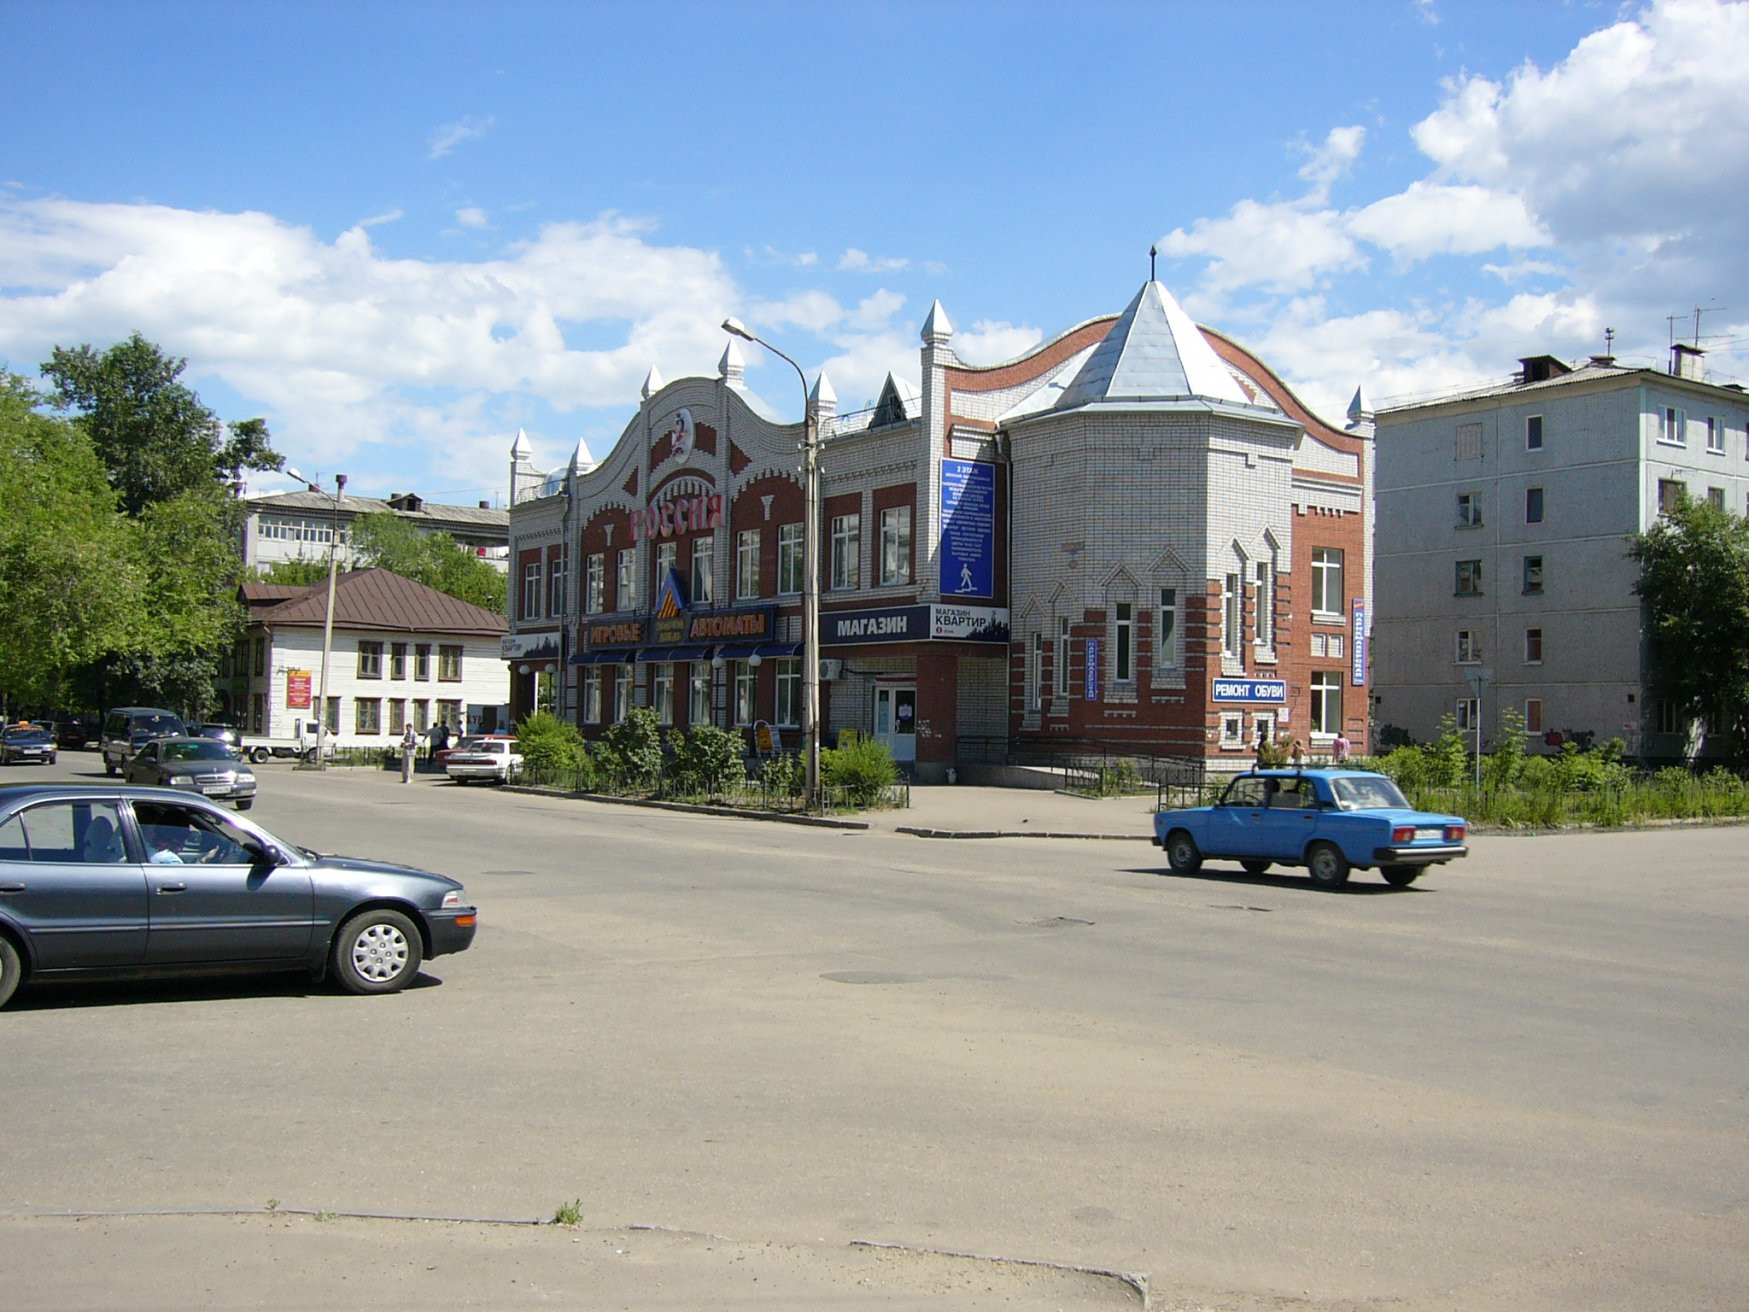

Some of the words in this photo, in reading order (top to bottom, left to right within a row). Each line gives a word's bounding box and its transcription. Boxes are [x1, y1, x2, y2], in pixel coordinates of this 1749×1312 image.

[629, 493, 727, 540] РОССИЯ
[935, 608, 971, 617] МАГАЗИН
[590, 623, 641, 644] ИГРОВЫЕ
[690, 613, 766, 638] АВТОМАТЫ
[837, 616, 908, 637] МАГАЗИН
[935, 616, 987, 628] КВАРТИР
[1215, 684, 1250, 697] РЕМОНТ
[1255, 685, 1283, 698] ОБУВИ
